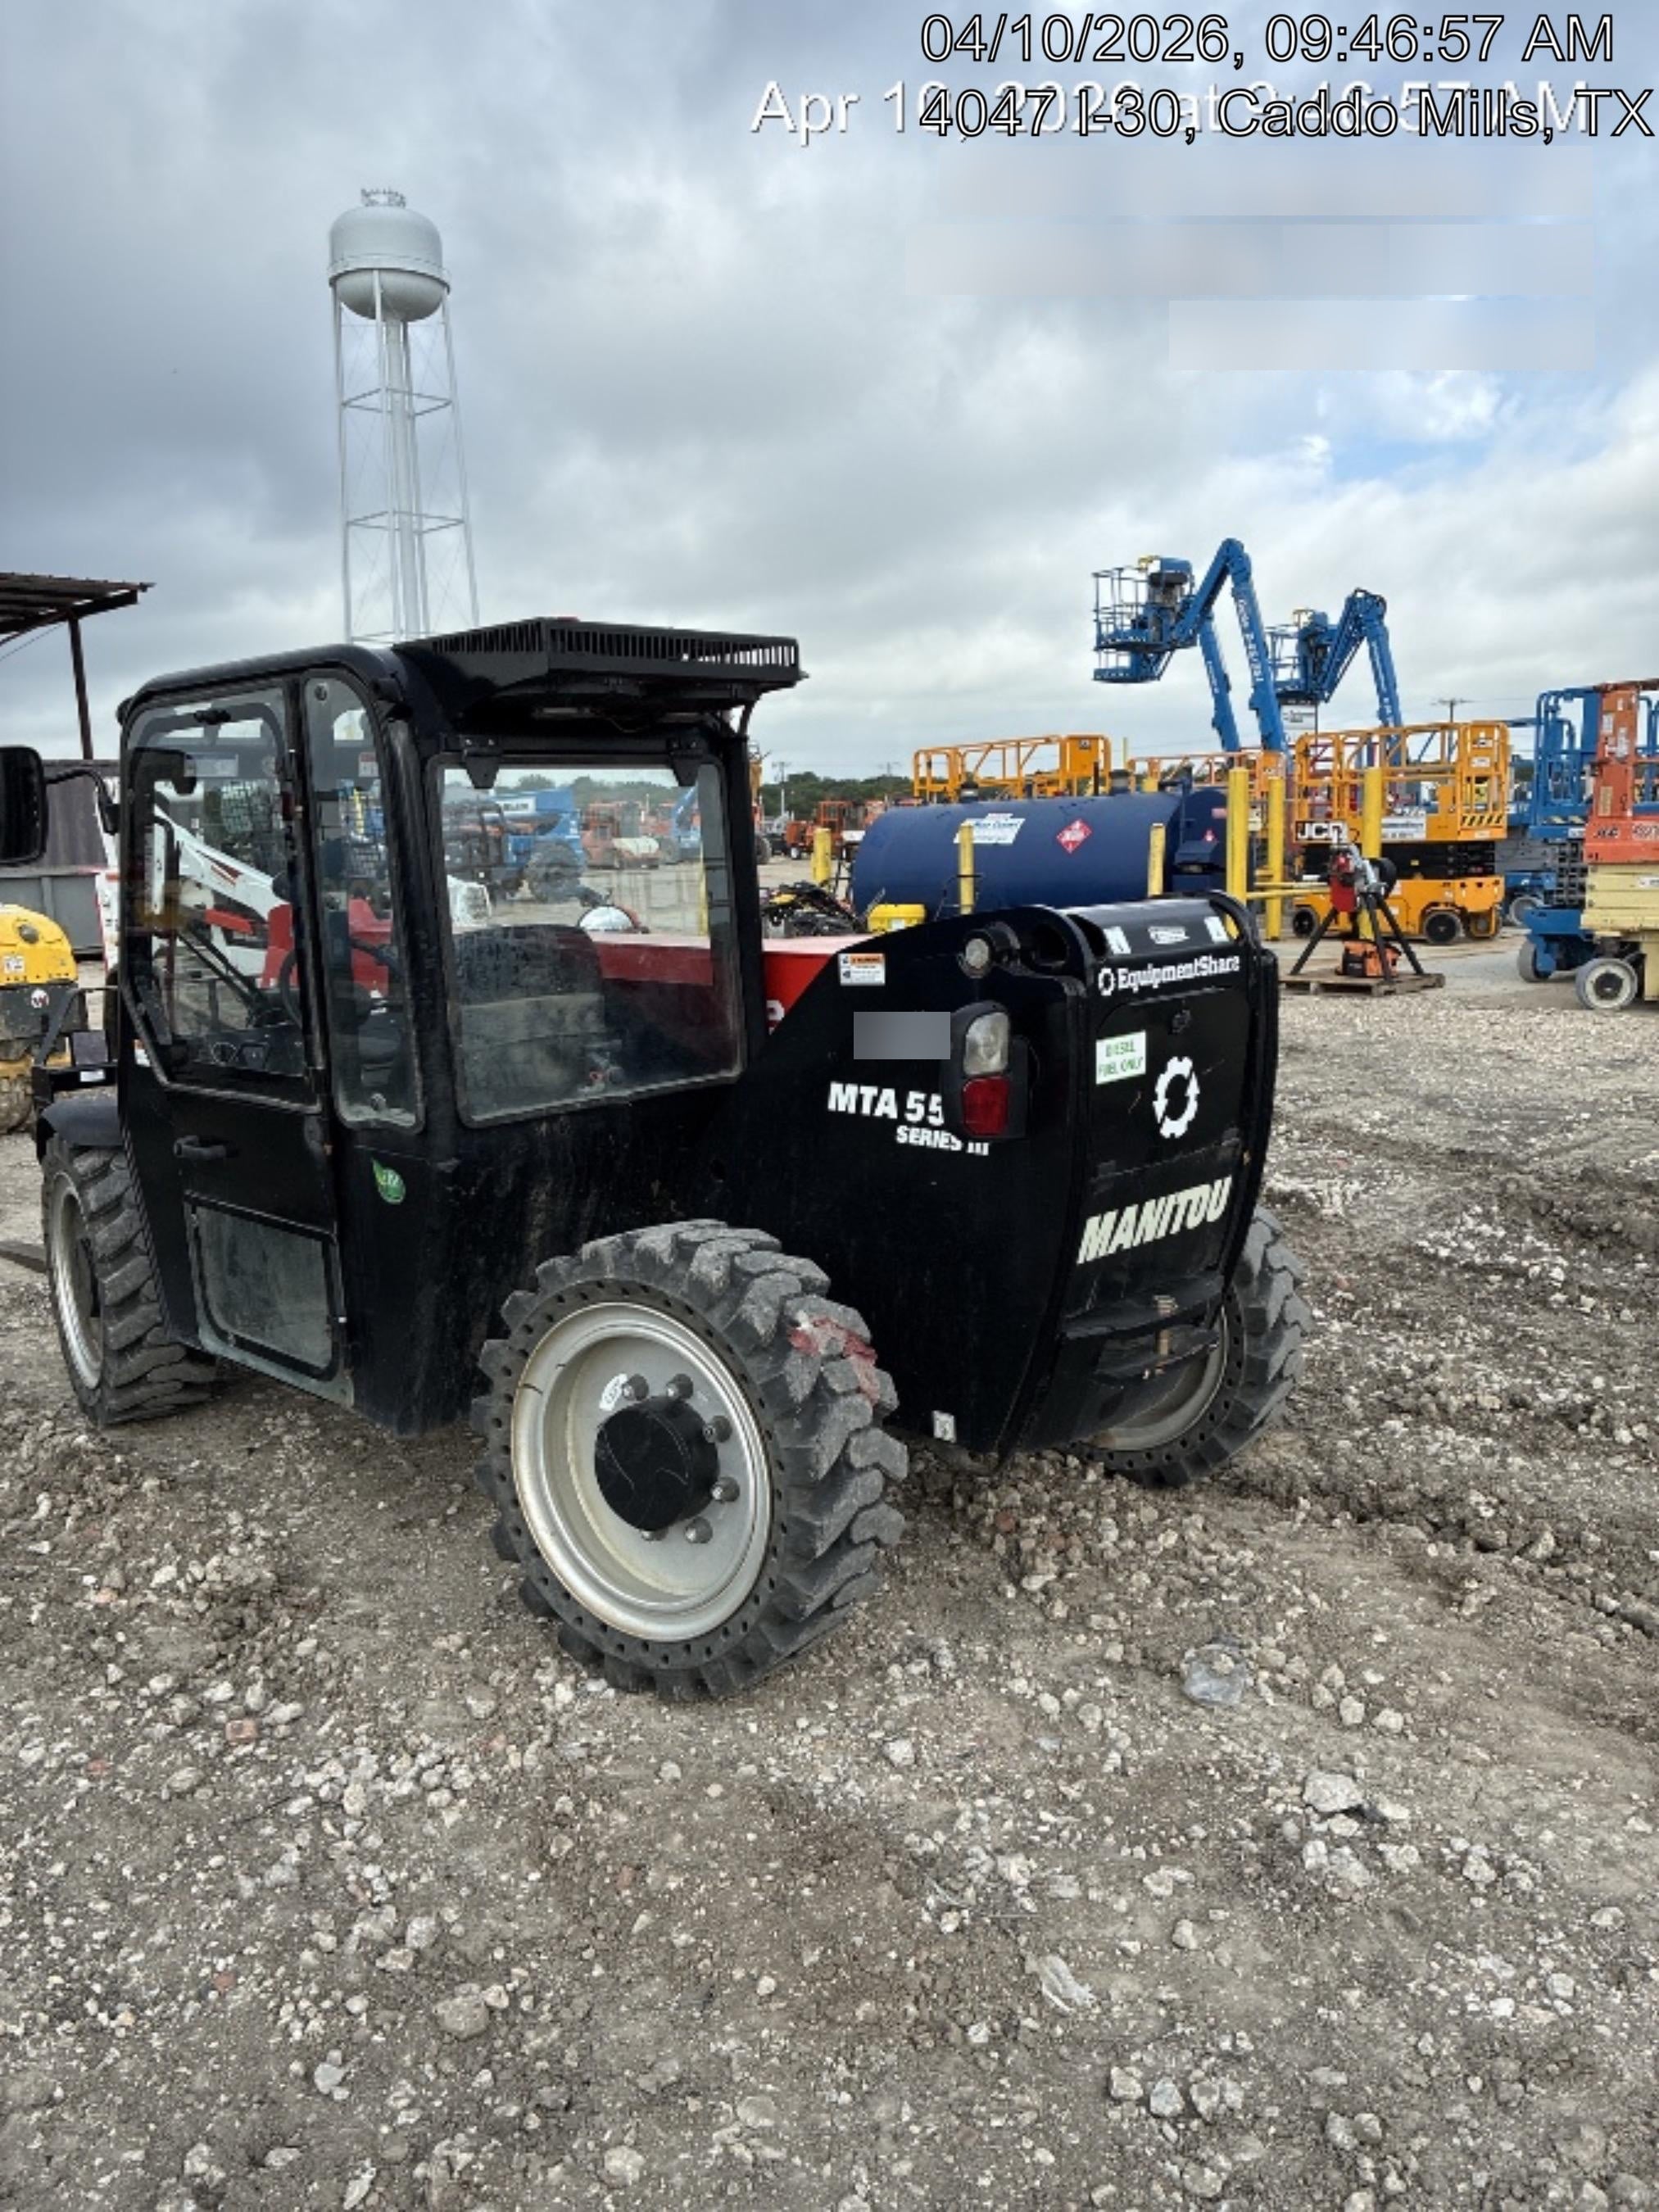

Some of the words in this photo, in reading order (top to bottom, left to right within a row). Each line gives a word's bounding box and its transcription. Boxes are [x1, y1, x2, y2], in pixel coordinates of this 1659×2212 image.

[1117, 954, 1240, 994] EquipmentShare
[827, 1080, 899, 1120] MTA
[895, 1124, 963, 1151] SERIES
[1076, 1174, 1233, 1265] MANITOU
